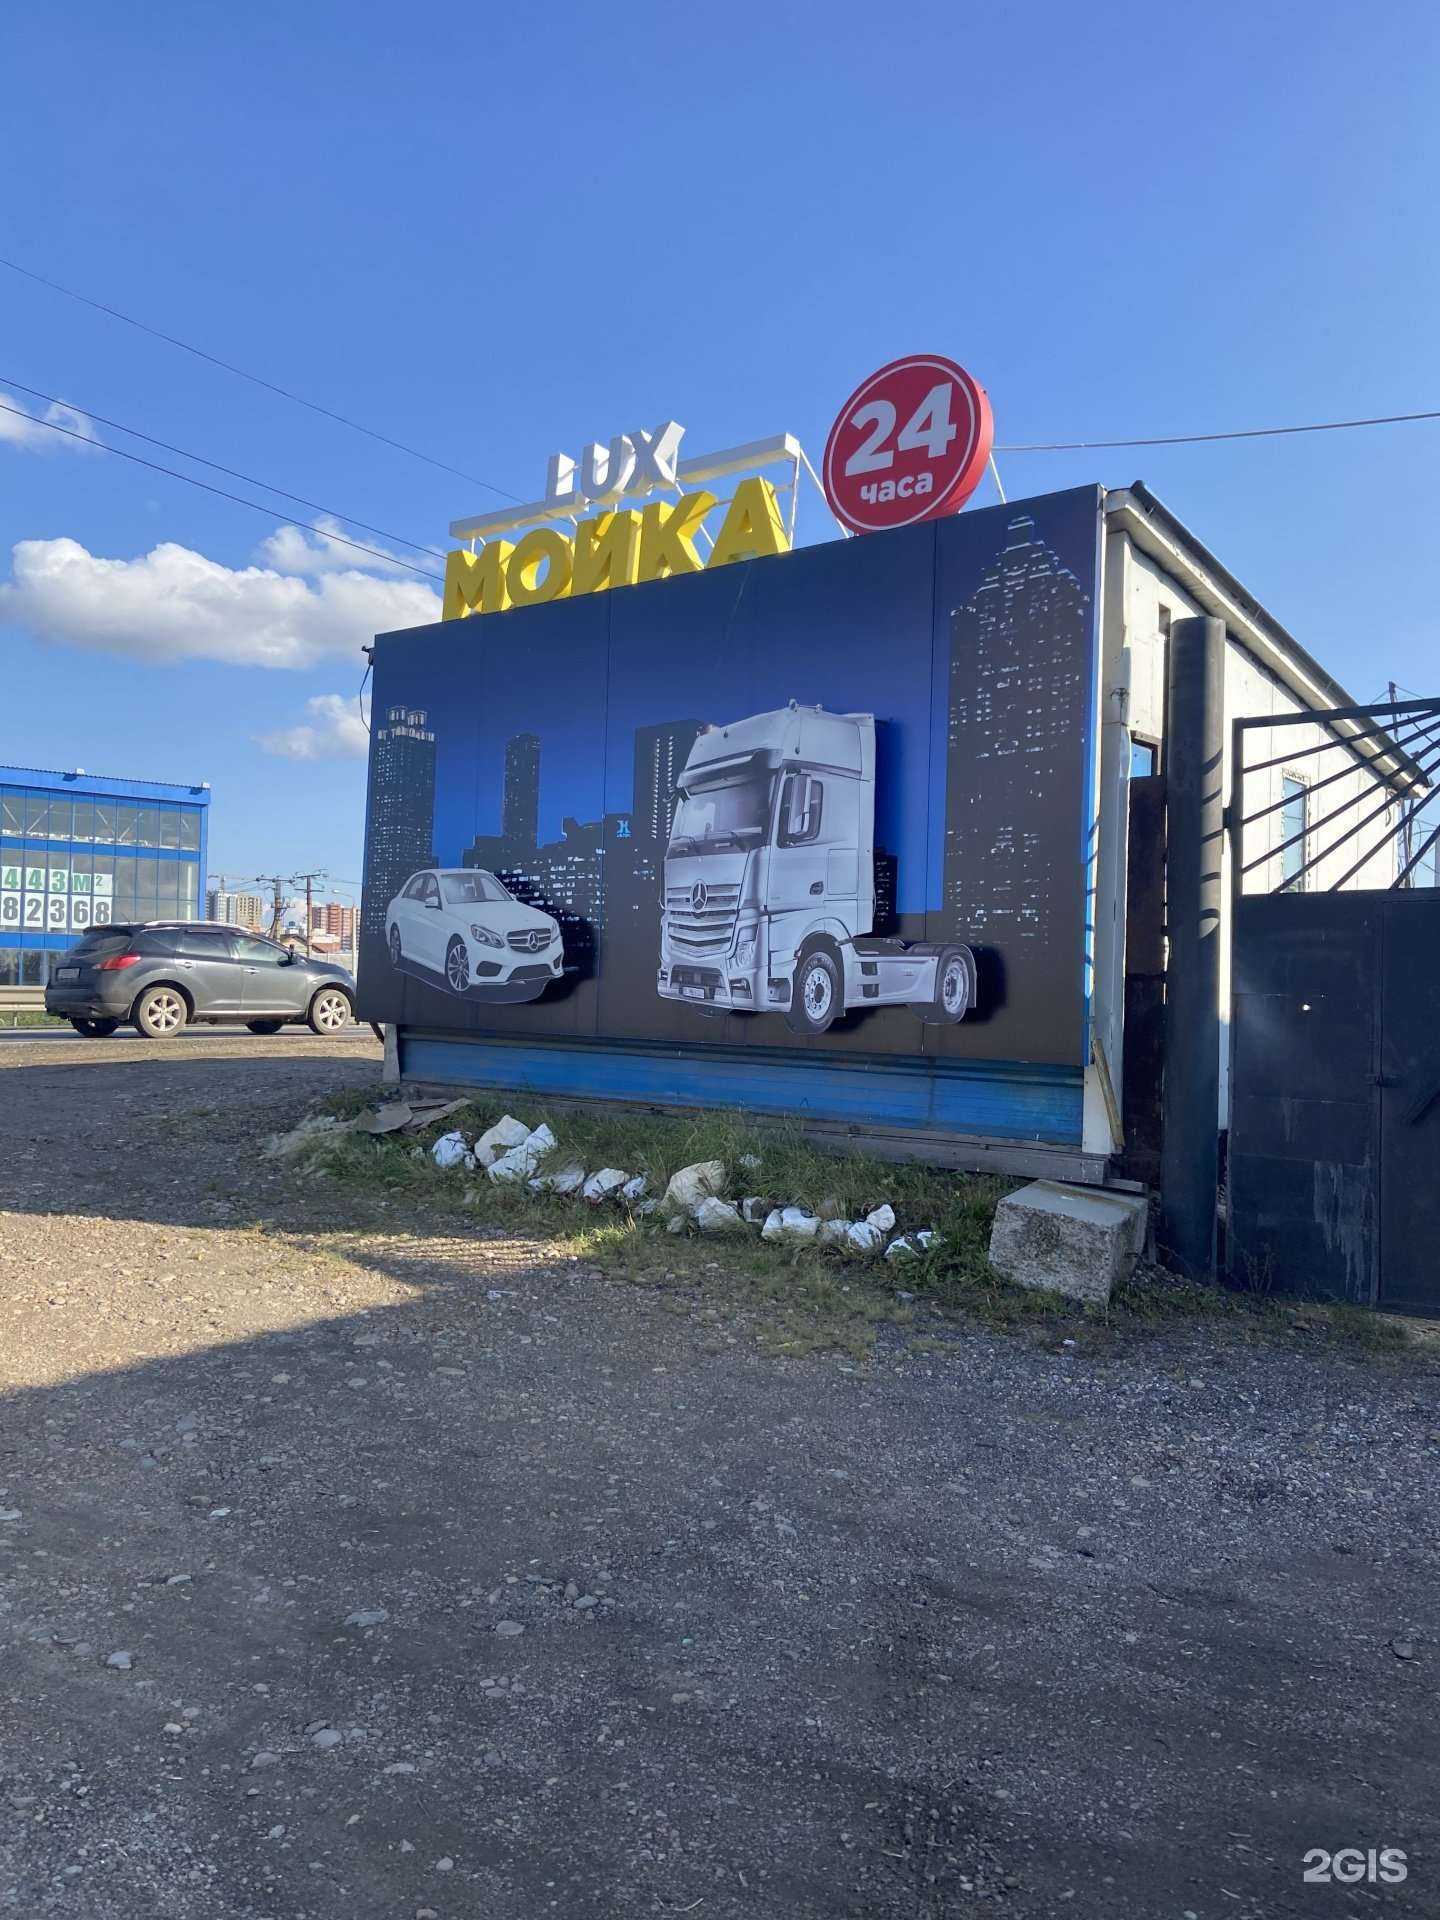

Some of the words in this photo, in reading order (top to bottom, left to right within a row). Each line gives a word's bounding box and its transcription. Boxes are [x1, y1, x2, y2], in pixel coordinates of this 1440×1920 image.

[545, 420, 686, 511] LUX
[845, 382, 957, 477] 24
[860, 472, 934, 505] часа
